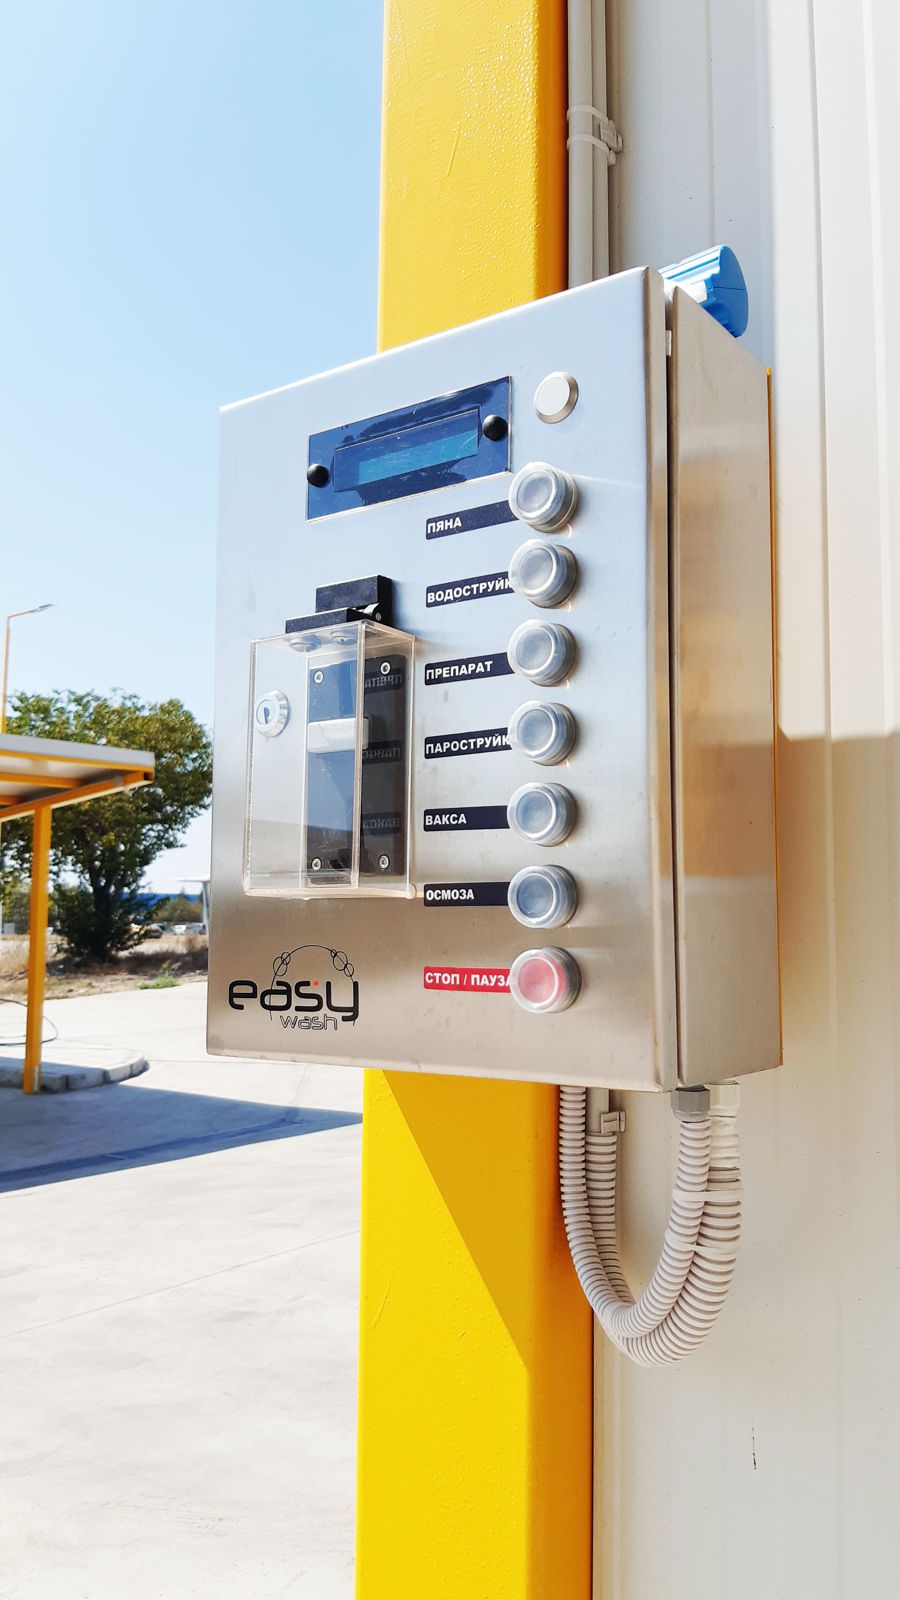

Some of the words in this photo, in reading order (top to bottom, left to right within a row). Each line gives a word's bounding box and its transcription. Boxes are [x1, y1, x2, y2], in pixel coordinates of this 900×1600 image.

[427, 517, 462, 534] ПЯНА
[426, 660, 493, 680] ПРЕПАРАТ
[425, 813, 467, 825] ВАКСА
[426, 888, 475, 900] ОСМОЗА
[425, 972, 460, 985] СТОП
[228, 979, 360, 1022] easy
[279, 1013, 338, 1031] wash
